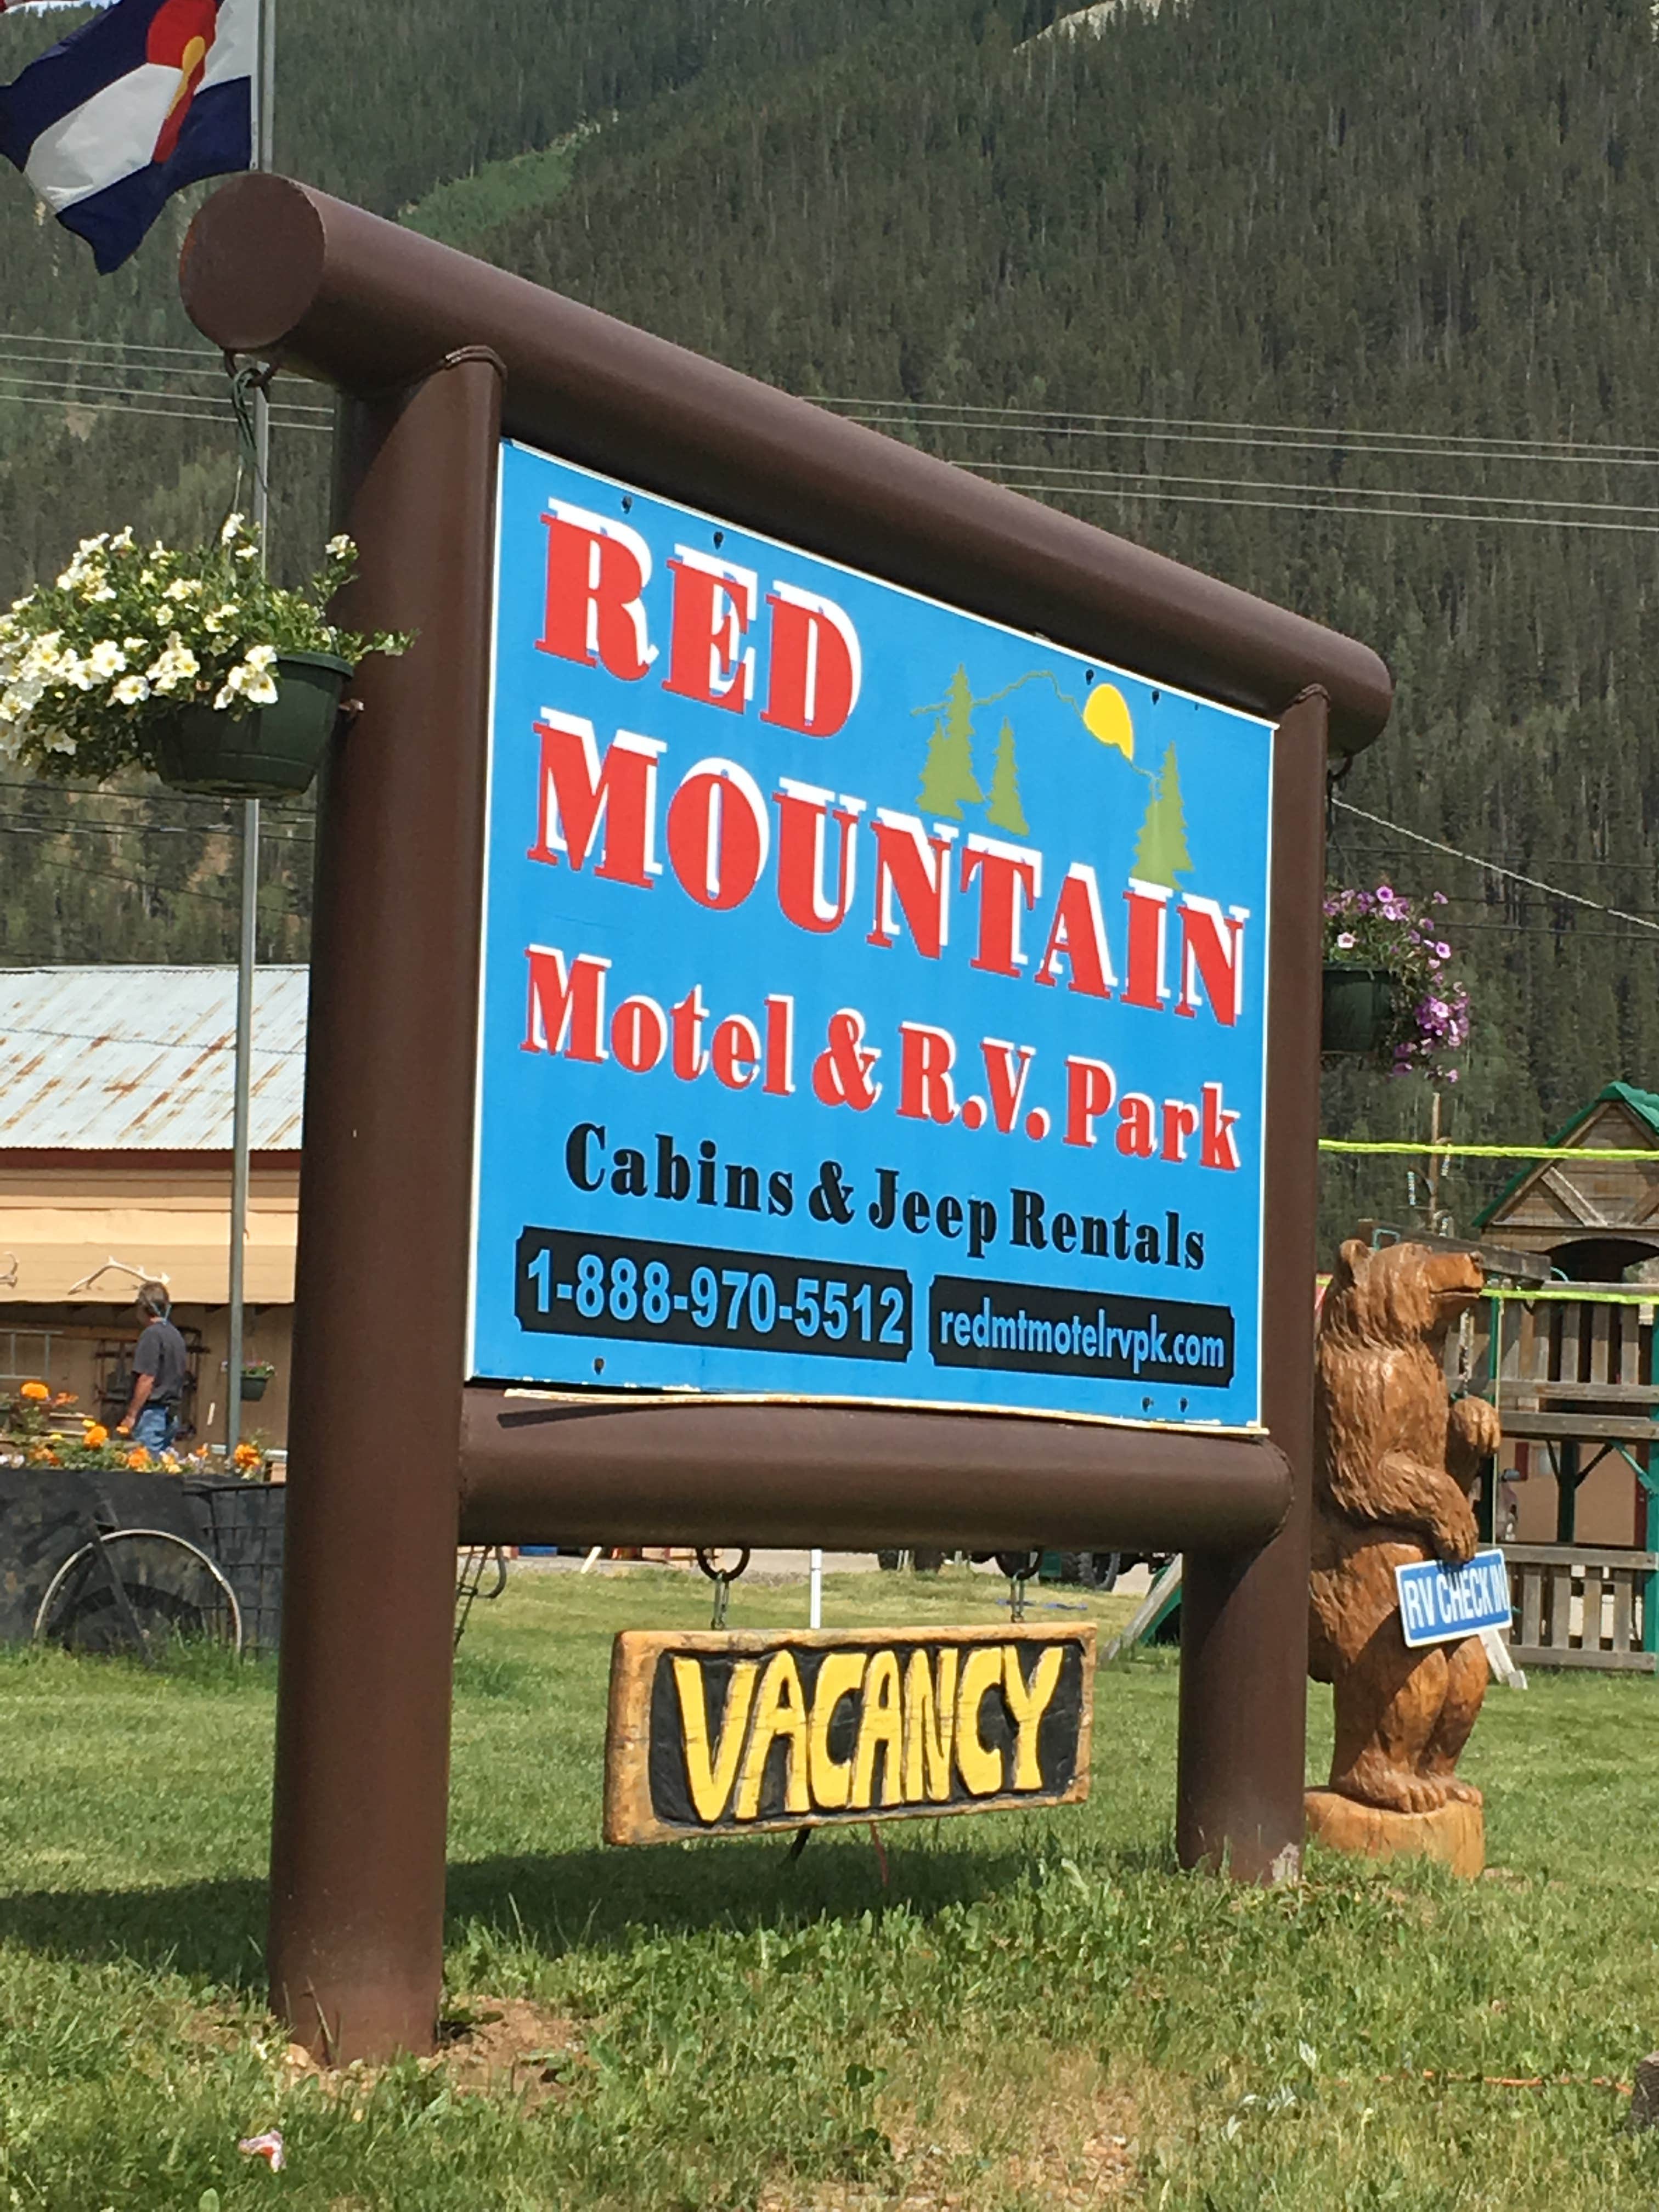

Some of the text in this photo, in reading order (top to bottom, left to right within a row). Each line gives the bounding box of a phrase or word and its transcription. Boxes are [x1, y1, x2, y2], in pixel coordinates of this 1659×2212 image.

[534, 498, 861, 737] RED
[527, 707, 1249, 1026] MOUNTAIN
[520, 944, 1240, 1171] Motel & R.V. Park
[565, 1122, 1205, 1271] Cabins & Jeep Rentals
[527, 1249, 905, 1344] 1-888-970-5512
[940, 1299, 1224, 1374] redmtmotelrvpk.com
[1403, 1563, 1508, 1629] RV CHECK IN
[673, 1645, 1063, 1821] VACANCY
